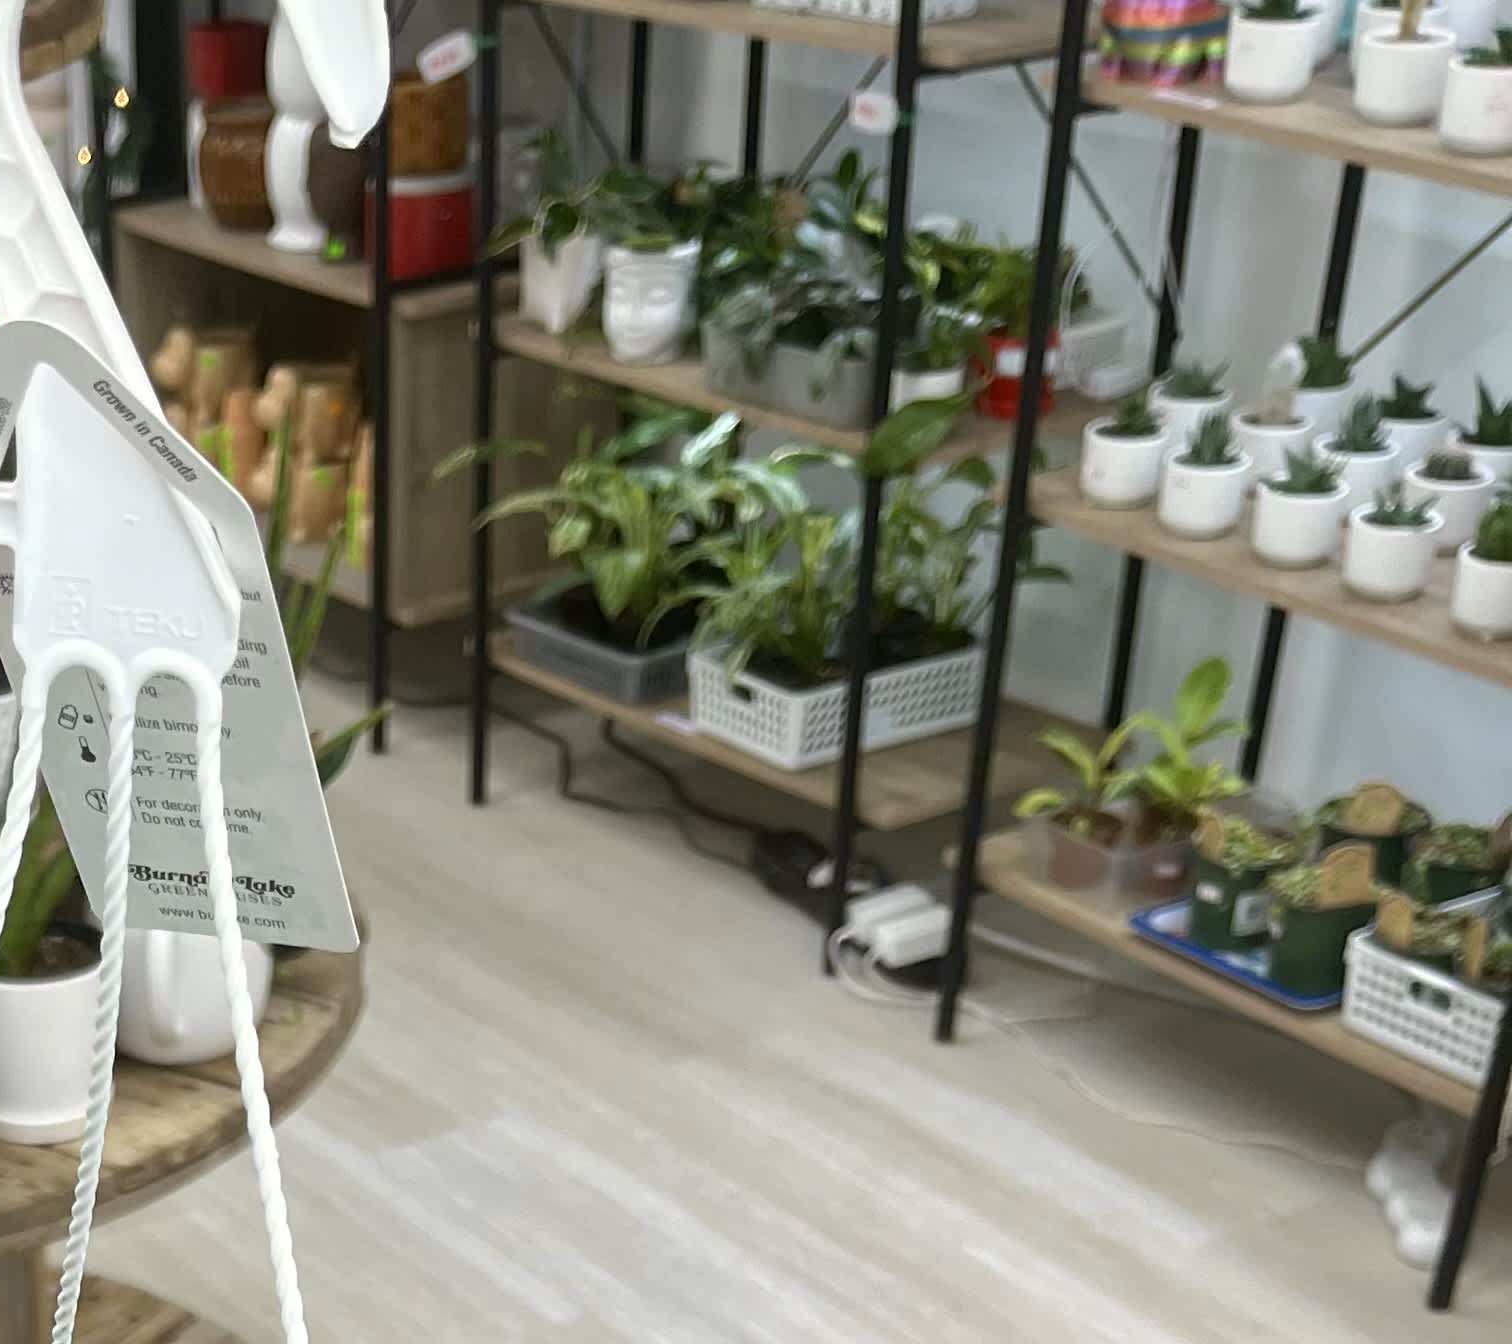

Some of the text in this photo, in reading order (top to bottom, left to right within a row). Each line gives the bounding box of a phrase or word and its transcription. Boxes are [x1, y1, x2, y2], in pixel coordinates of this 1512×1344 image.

[93, 380, 198, 482] Grown in Canada
[164, 718, 231, 738] bimoly
[136, 796, 157, 809] For
[162, 799, 230, 817] decorn
[142, 811, 160, 824] Do
[164, 814, 185, 827] not
[128, 864, 296, 898] Burna Lake
[148, 883, 283, 907] GREENUSES
